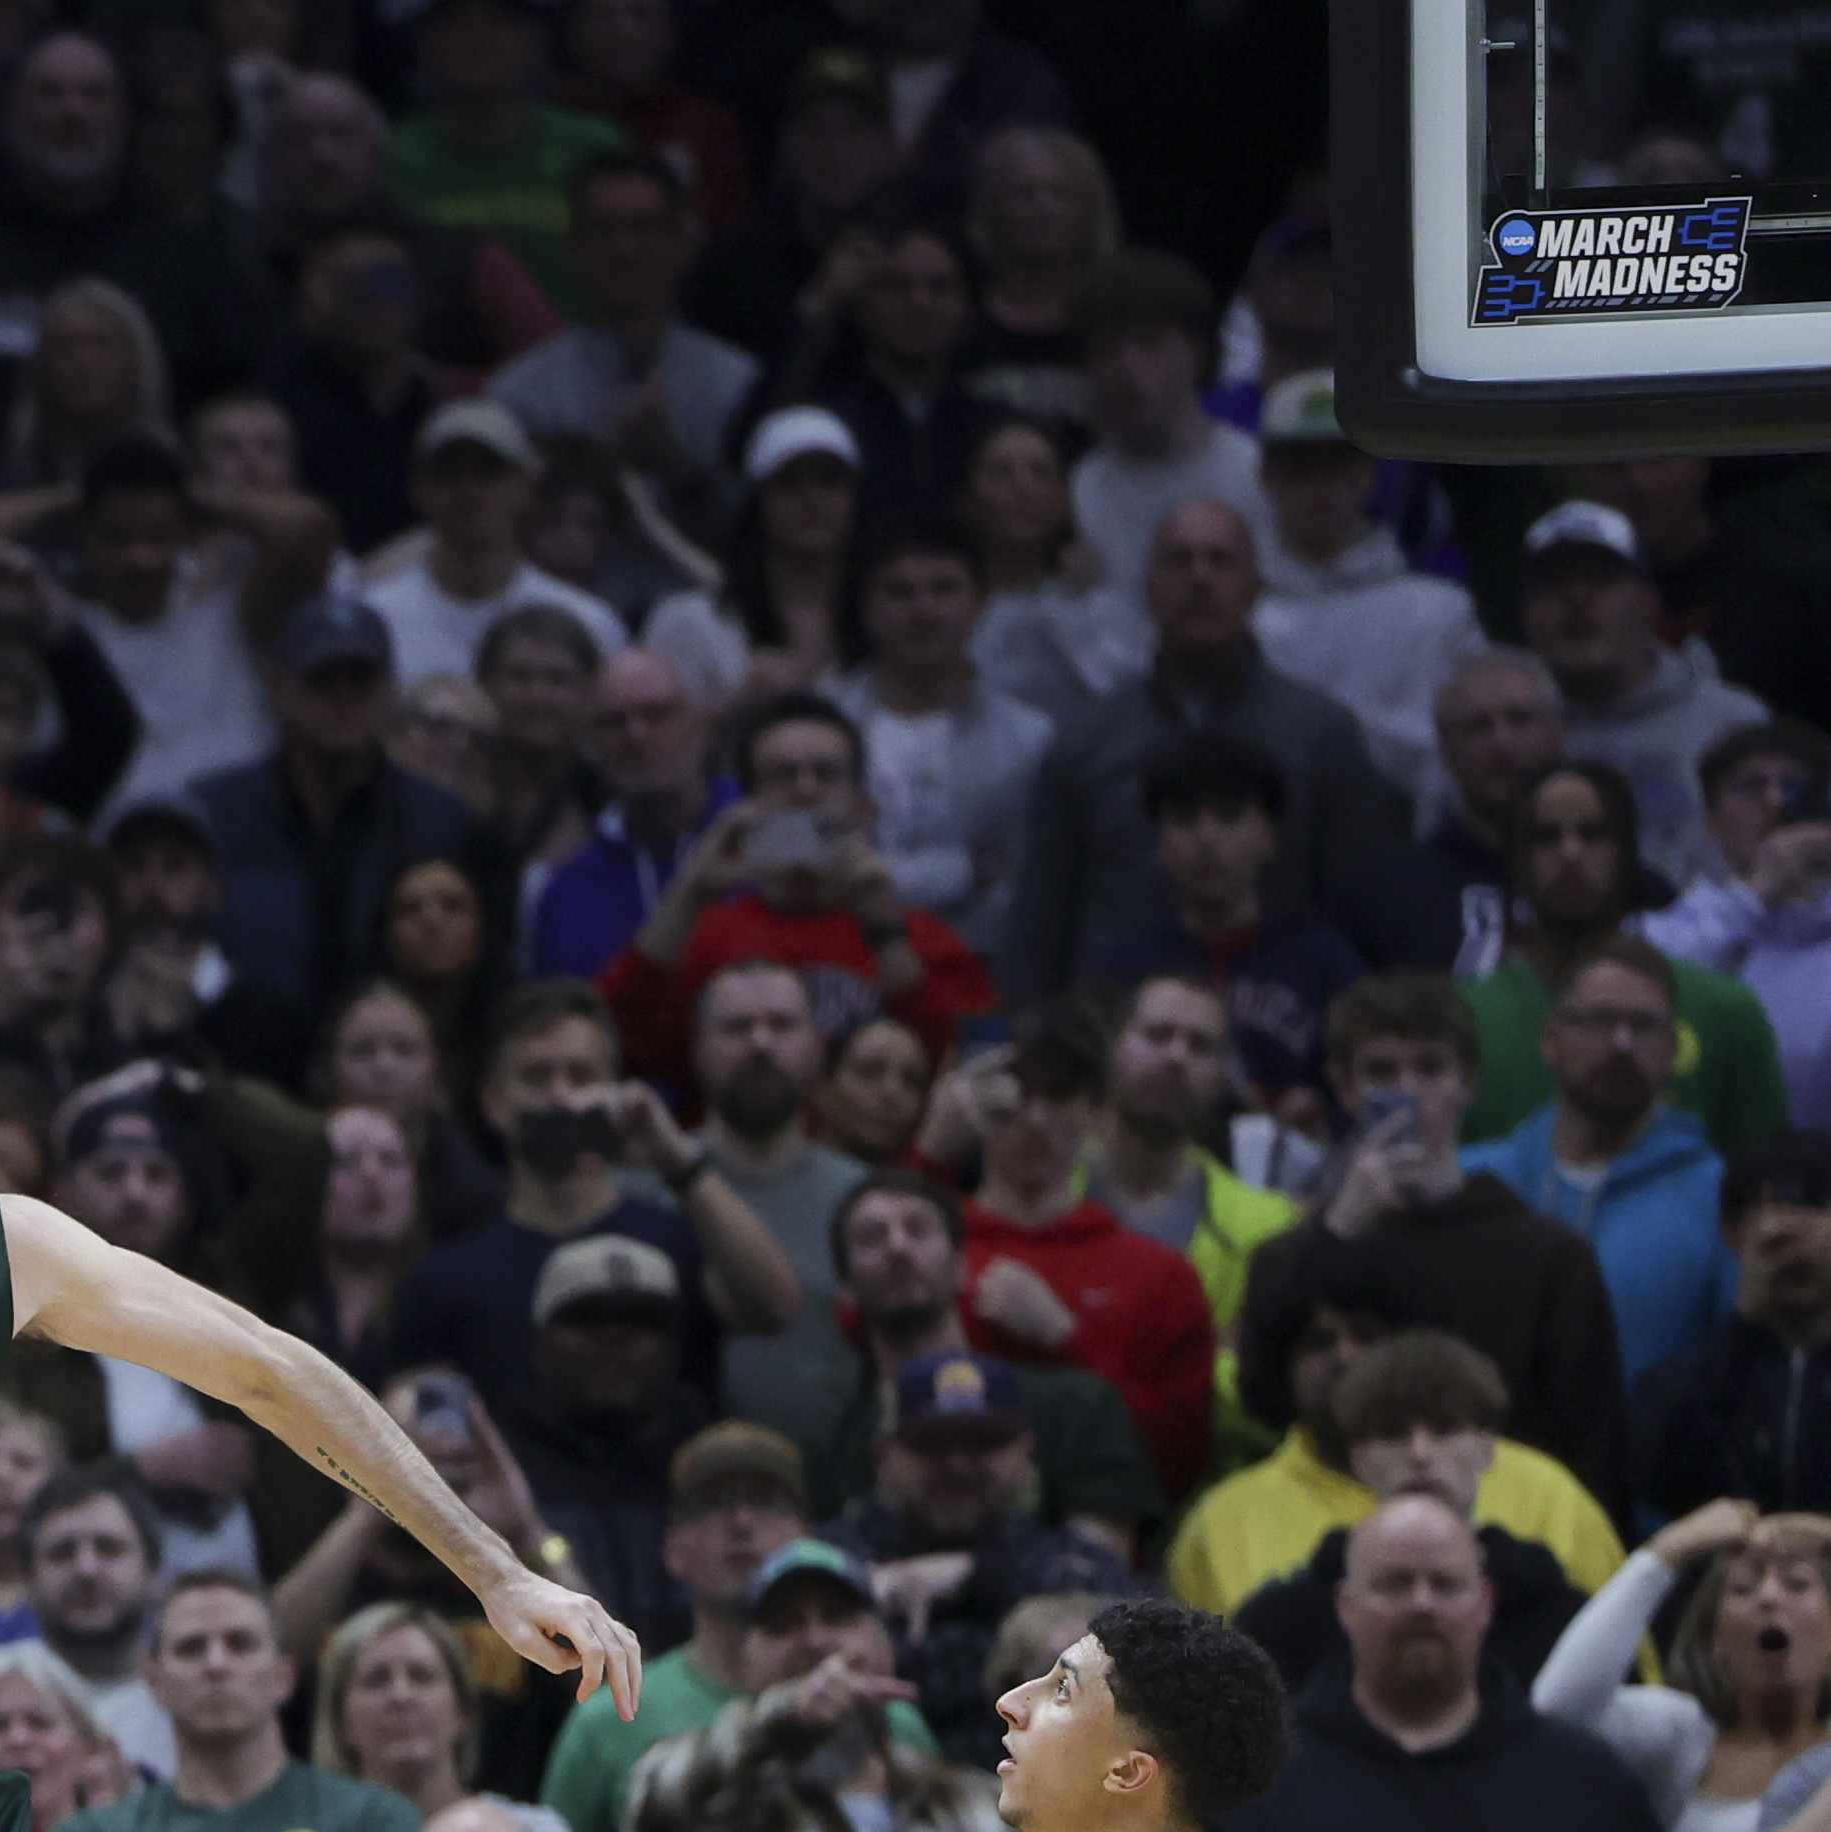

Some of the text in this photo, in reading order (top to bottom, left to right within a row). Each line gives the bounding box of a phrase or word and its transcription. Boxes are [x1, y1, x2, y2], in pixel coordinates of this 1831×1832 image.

[1502, 236, 1536, 247] NCAA
[1537, 215, 1675, 258] MARCH
[1553, 253, 1739, 298] MADNESS
